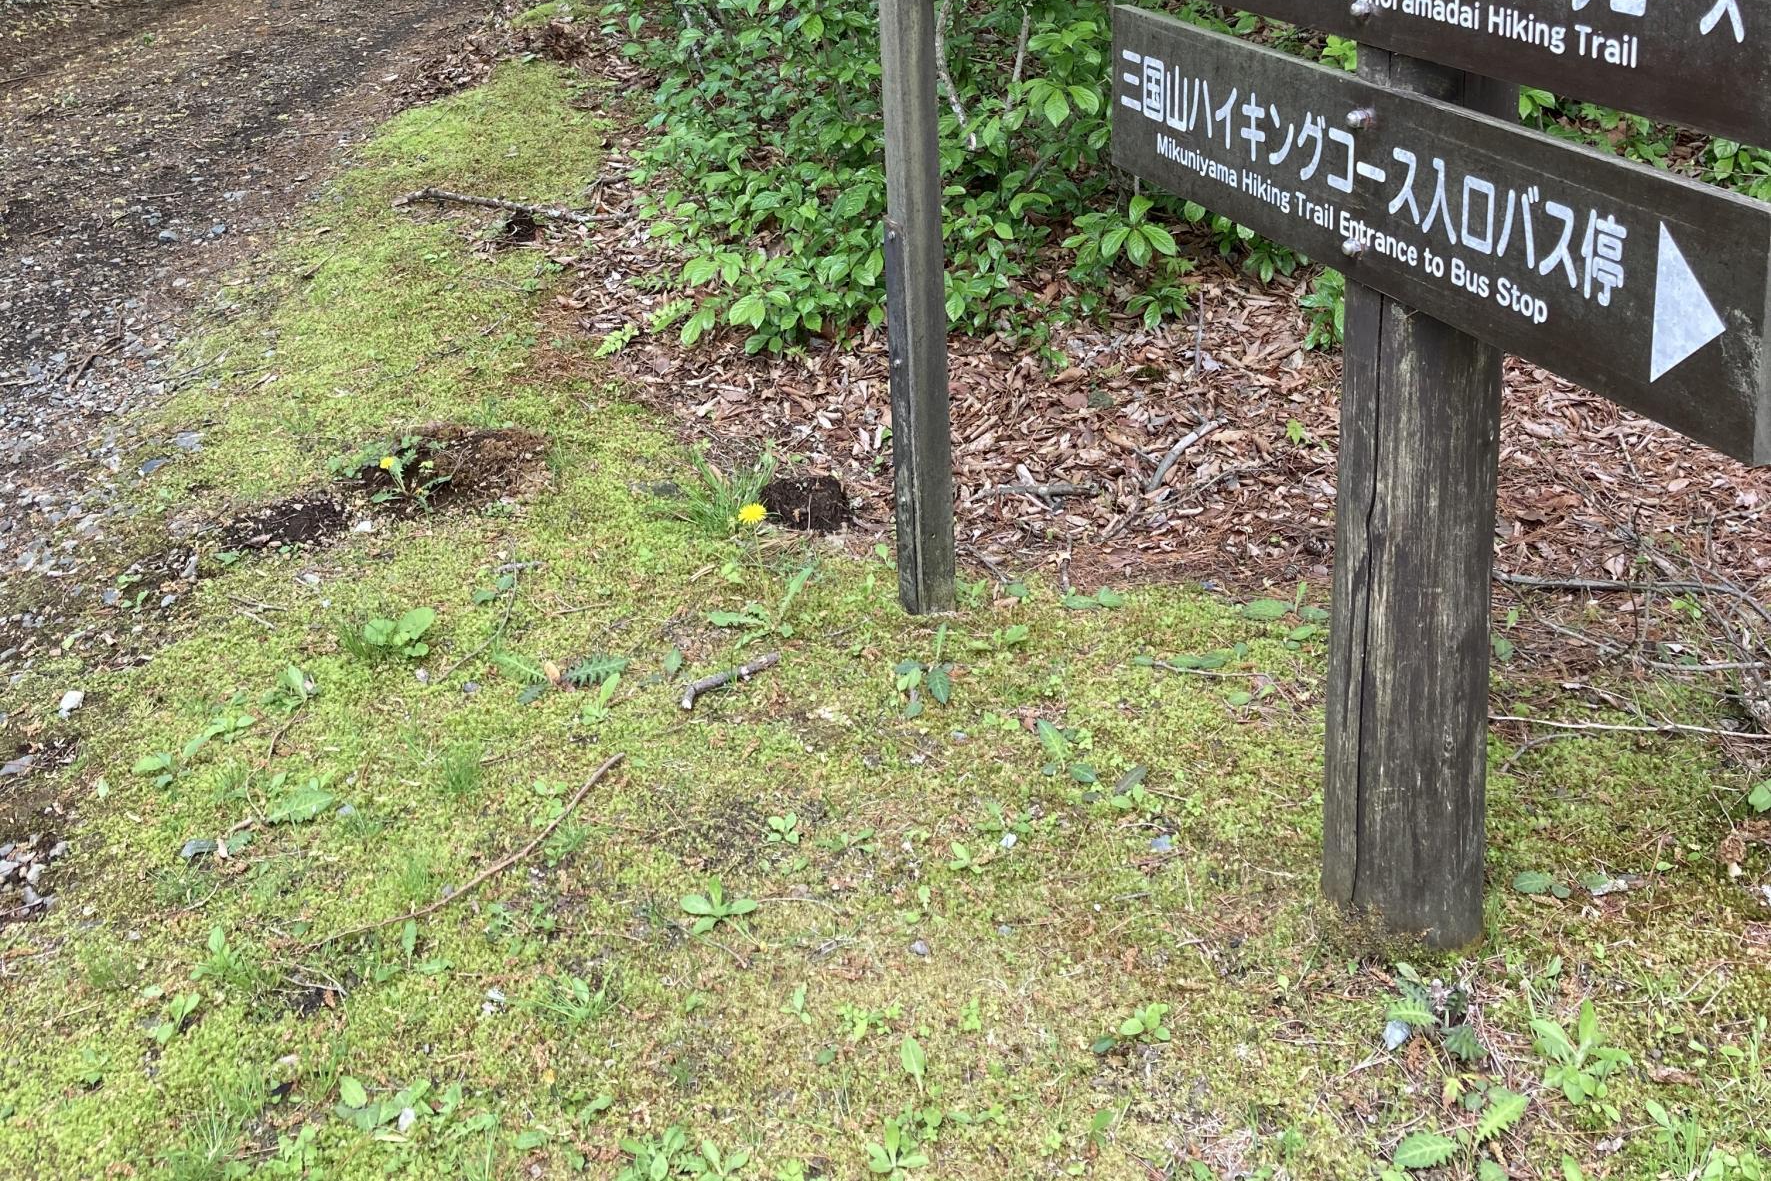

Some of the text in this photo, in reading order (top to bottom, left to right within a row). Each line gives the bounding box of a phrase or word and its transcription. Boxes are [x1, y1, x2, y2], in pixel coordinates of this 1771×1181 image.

[1487, 4, 1566, 56] Hiking
[1575, 23, 1639, 70] Trail
[1120, 48, 1628, 308] 三国山ハイキングコース入口バス停
[1156, 135, 1549, 326] Mikuniyama Hiking Trail Entrance to Bus Stop
